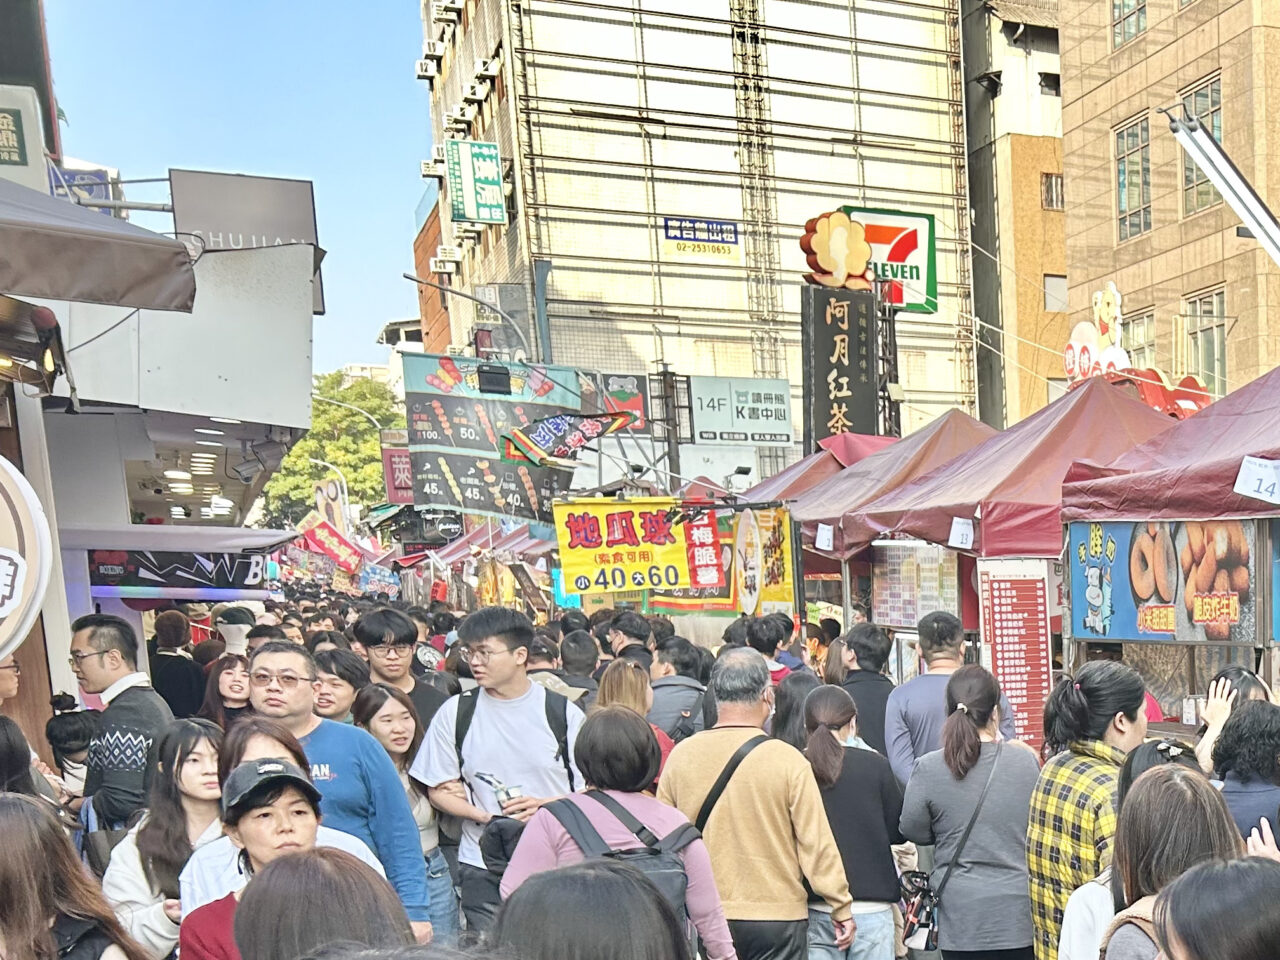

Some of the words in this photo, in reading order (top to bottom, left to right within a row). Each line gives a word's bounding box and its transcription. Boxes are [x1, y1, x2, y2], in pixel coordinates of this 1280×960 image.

[864, 223, 918, 263] 7
[697, 397, 727, 412] 14F
[1253, 478, 1277, 497] 14
[566, 510, 677, 549] 地瓜球
[594, 566, 626, 590] 40
[648, 564, 680, 587] 60
